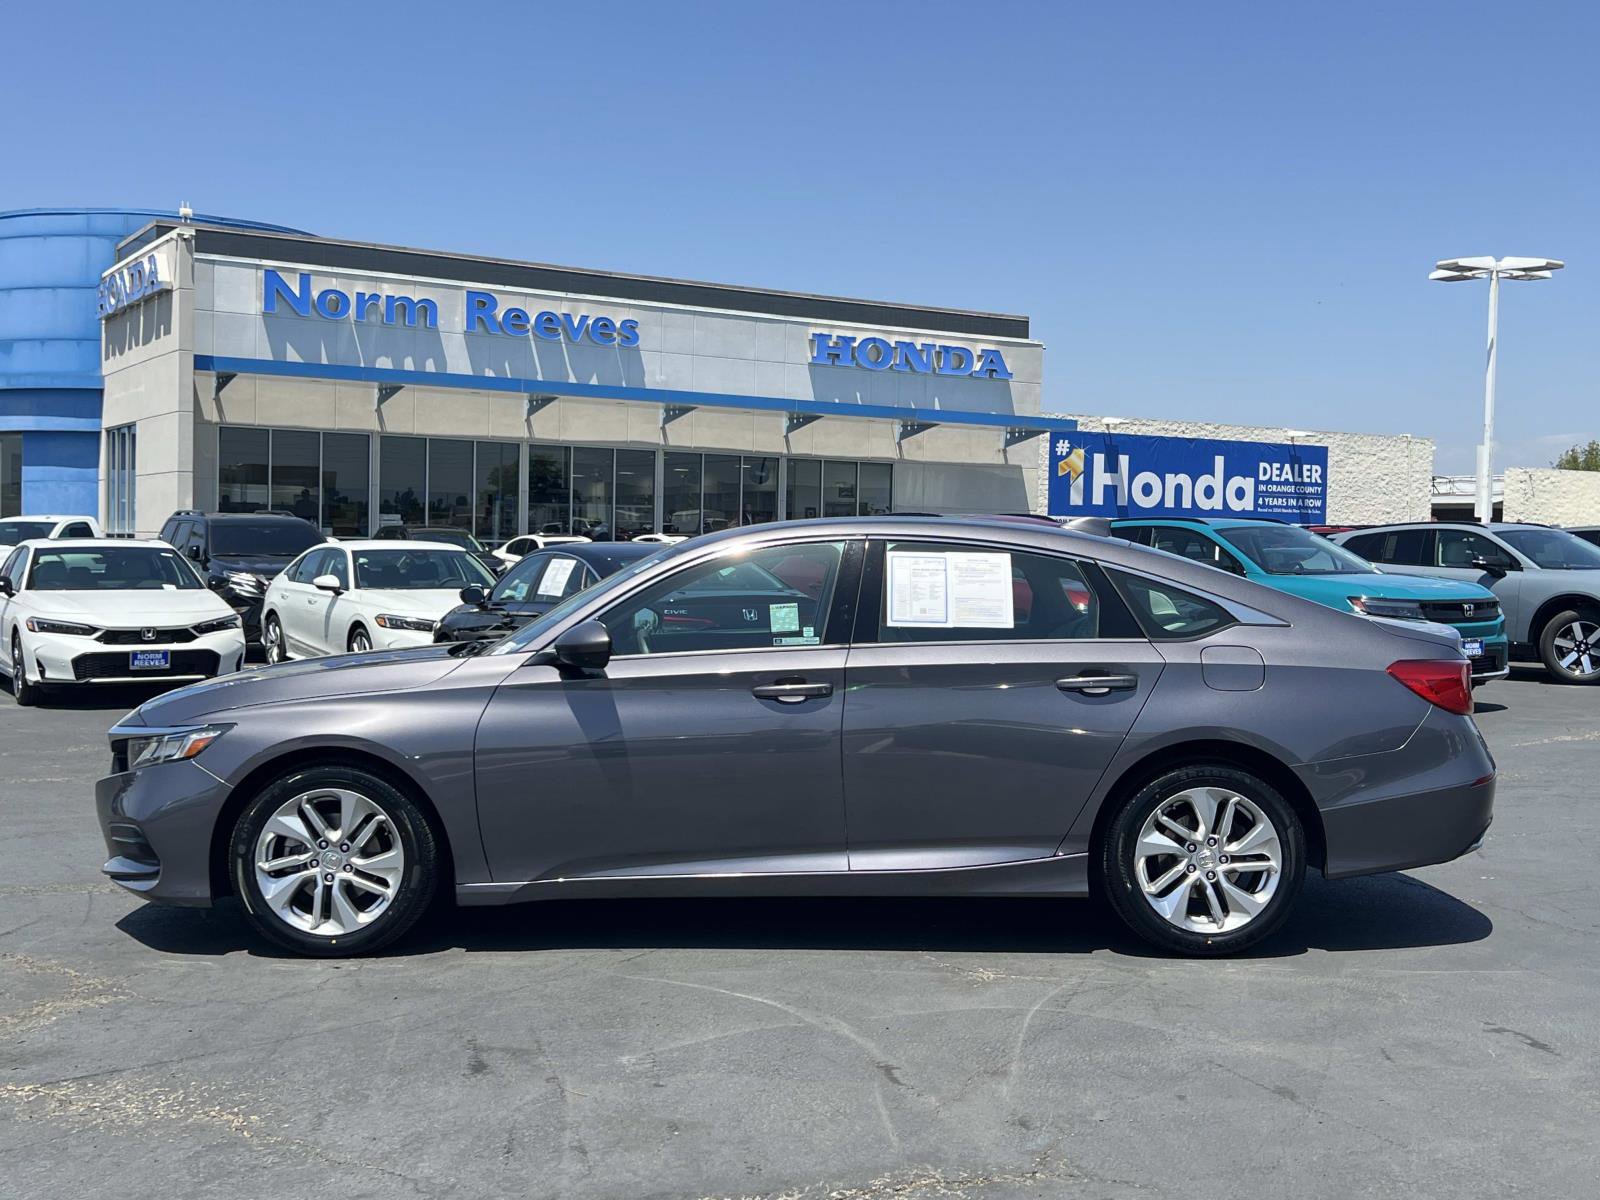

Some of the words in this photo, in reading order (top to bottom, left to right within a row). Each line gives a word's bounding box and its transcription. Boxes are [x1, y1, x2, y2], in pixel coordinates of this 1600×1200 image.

[96, 254, 160, 320] HONDA
[263, 269, 438, 329] Norm
[465, 290, 640, 347] Reeves
[811, 333, 1013, 380] HONDA
[1092, 453, 1254, 511] Honda
[1259, 462, 1321, 483] DEALER
[1267, 484, 1295, 493] ORANGE
[1296, 486, 1322, 494] COUNTY
[1258, 497, 1263, 506] 4
[1264, 497, 1287, 506] YEARS
[1288, 498, 1297, 506] IN
[1298, 499, 1303, 507] A
[1304, 499, 1322, 508] ROW
